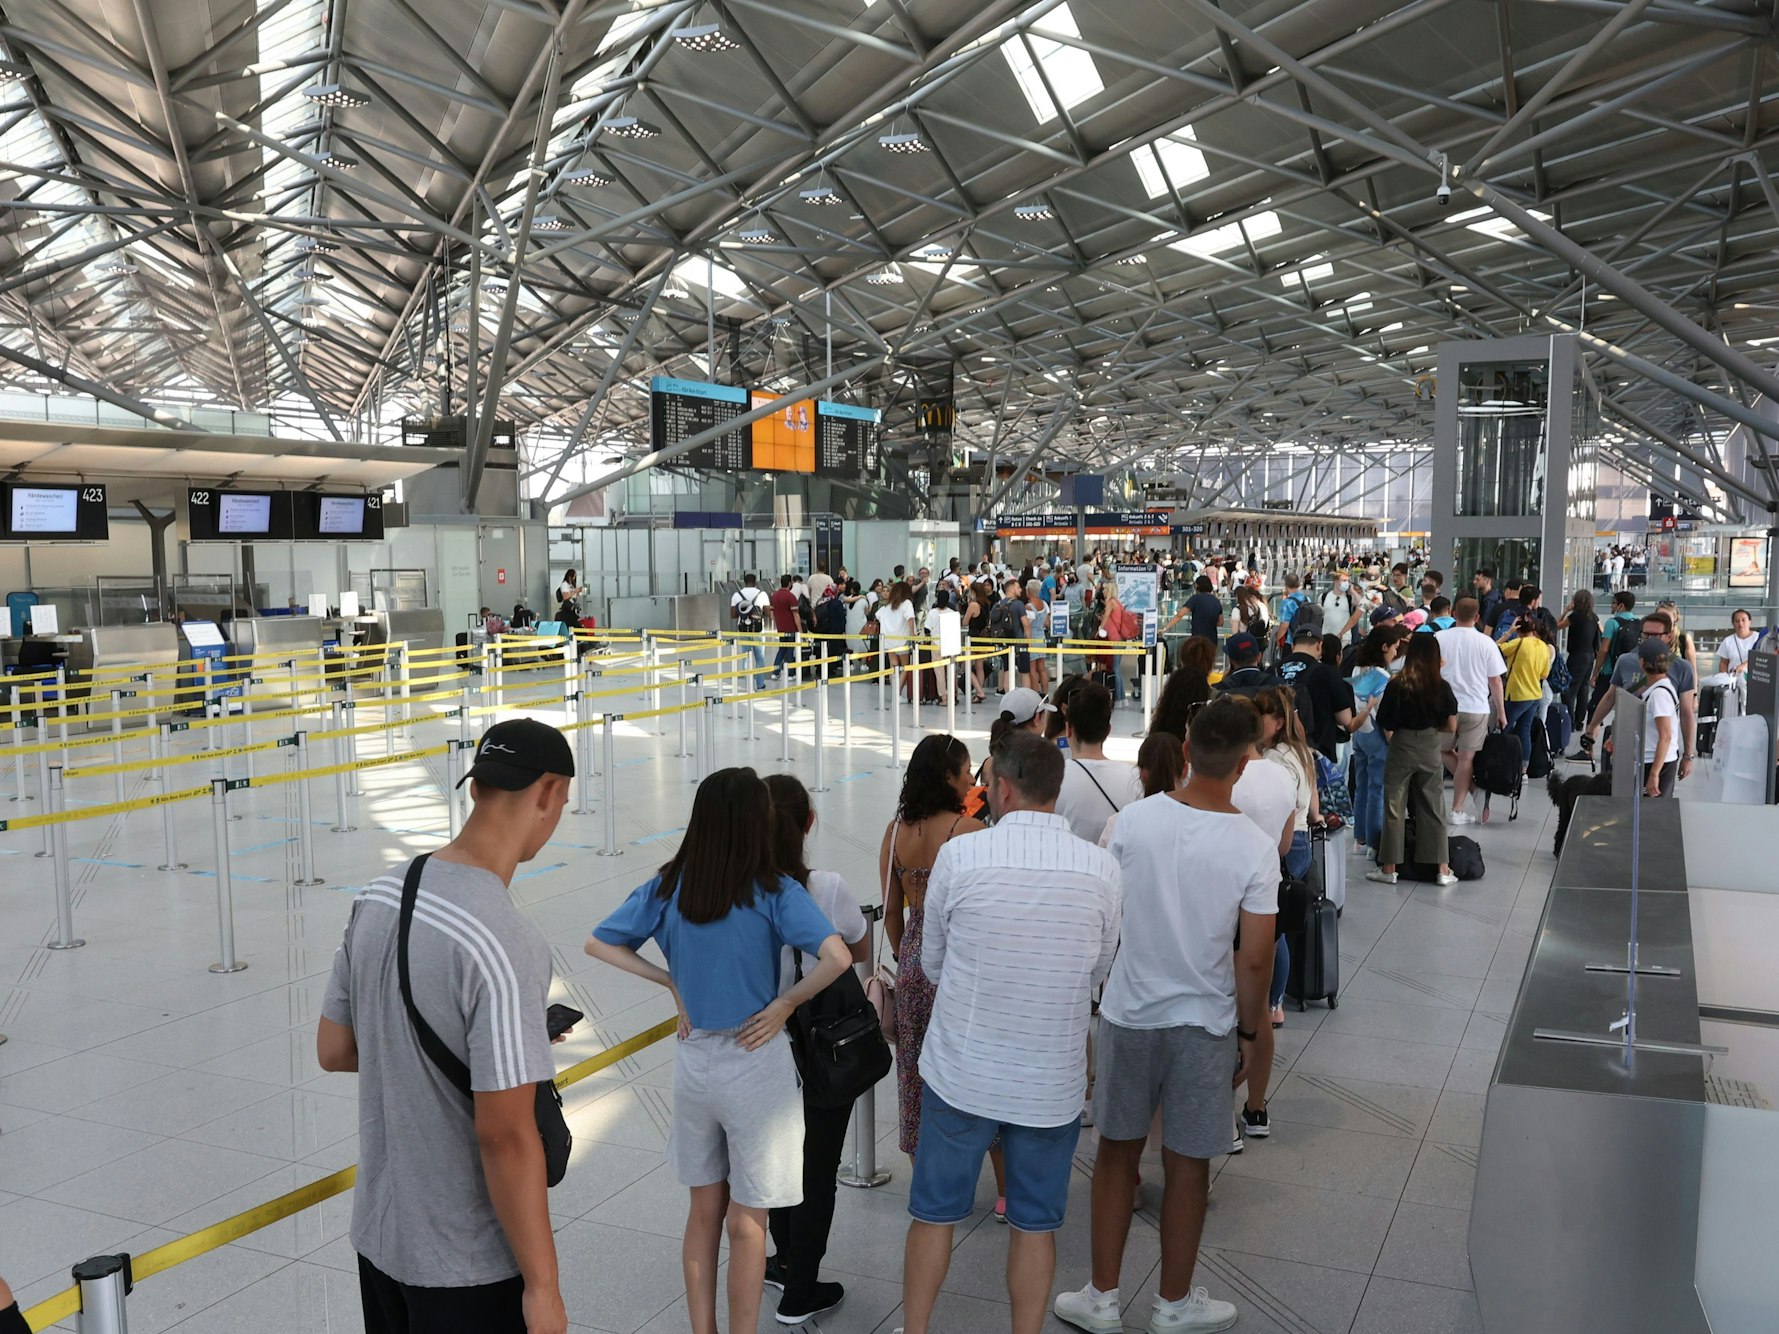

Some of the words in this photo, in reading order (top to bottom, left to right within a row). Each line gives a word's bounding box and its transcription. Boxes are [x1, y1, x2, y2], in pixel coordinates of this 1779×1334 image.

[82, 488, 104, 502] 423
[191, 492, 210, 505] 422
[367, 496, 381, 509] 421
